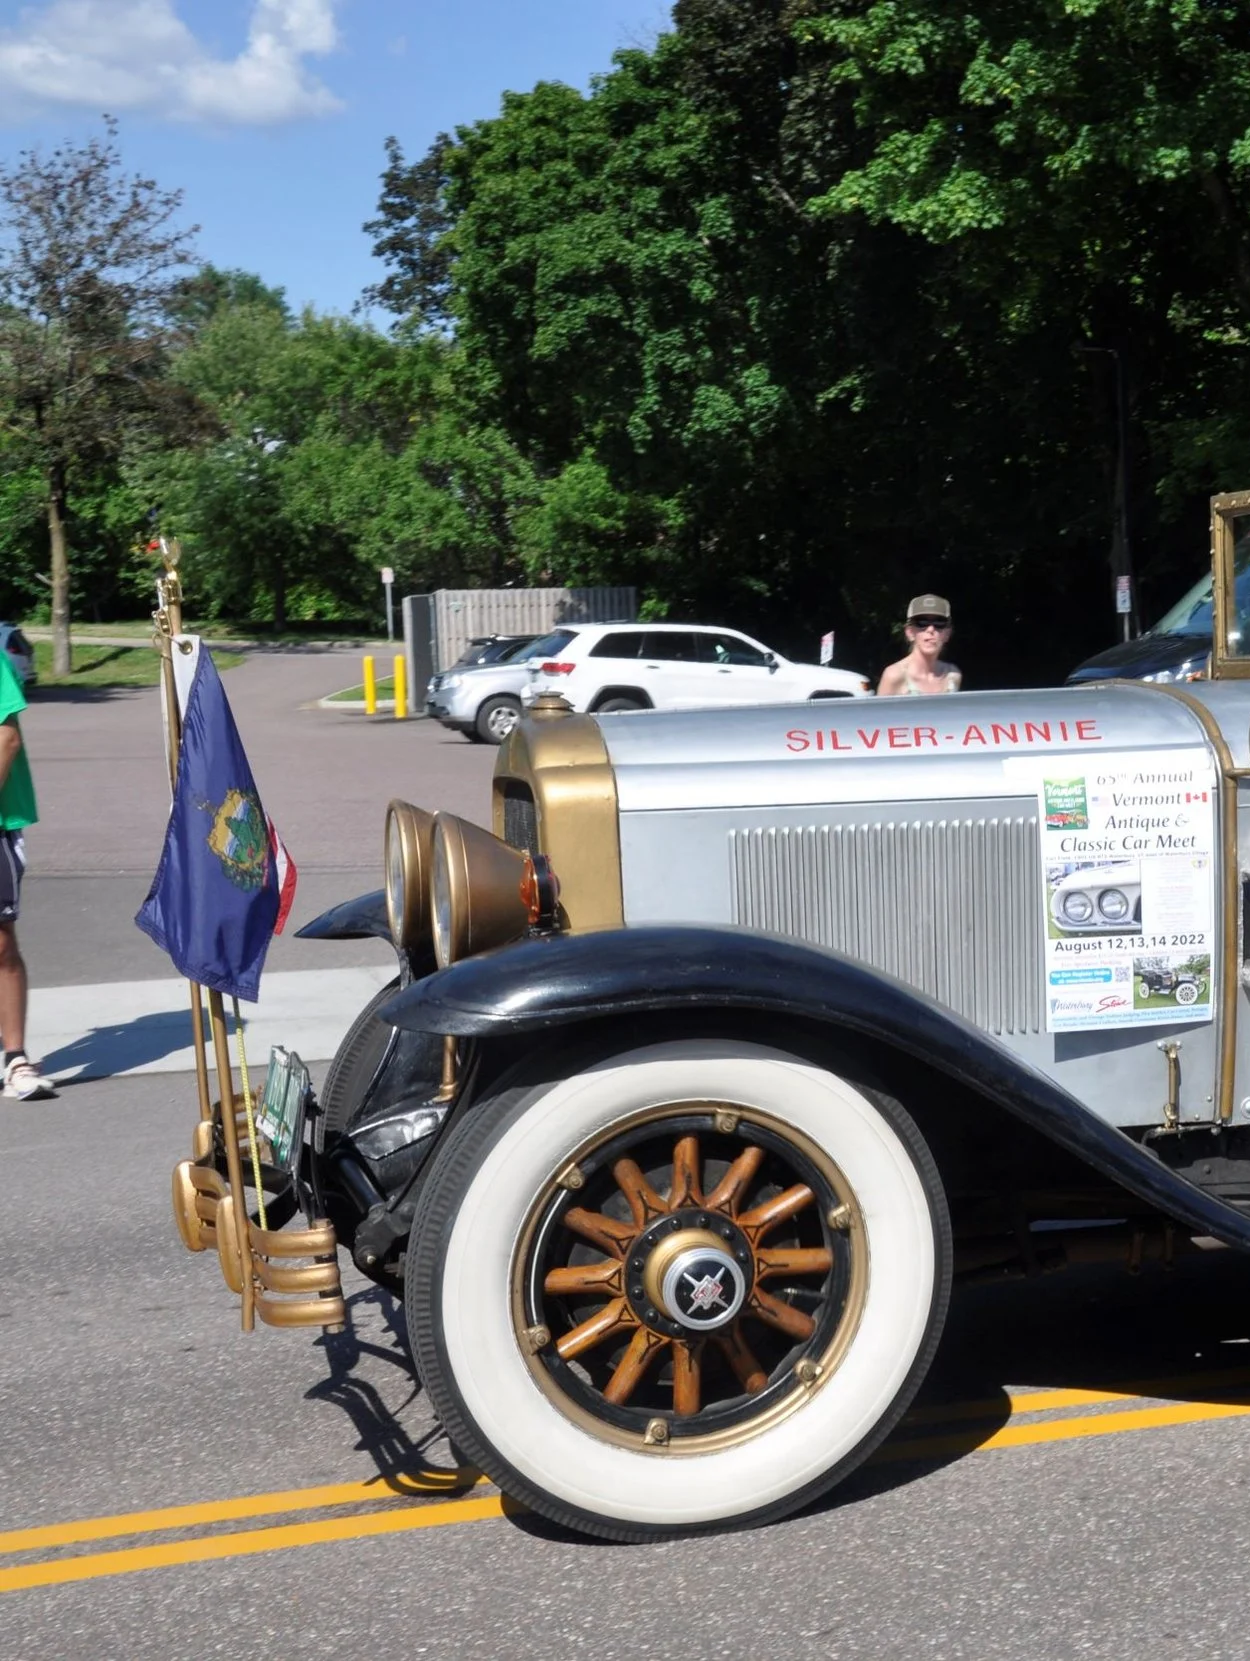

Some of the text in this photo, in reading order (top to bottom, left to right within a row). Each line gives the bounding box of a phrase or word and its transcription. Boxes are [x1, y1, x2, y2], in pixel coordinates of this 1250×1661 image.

[786, 719, 1102, 752] SILVER-ANNIE
[1132, 770, 1193, 784] Annual
[1112, 792, 1181, 807] Vermont
[1105, 813, 1190, 832] Antique &
[1060, 834, 1196, 852] Classic Car Meet
[1054, 940, 1102, 954] August
[1171, 933, 1205, 946] 2022
